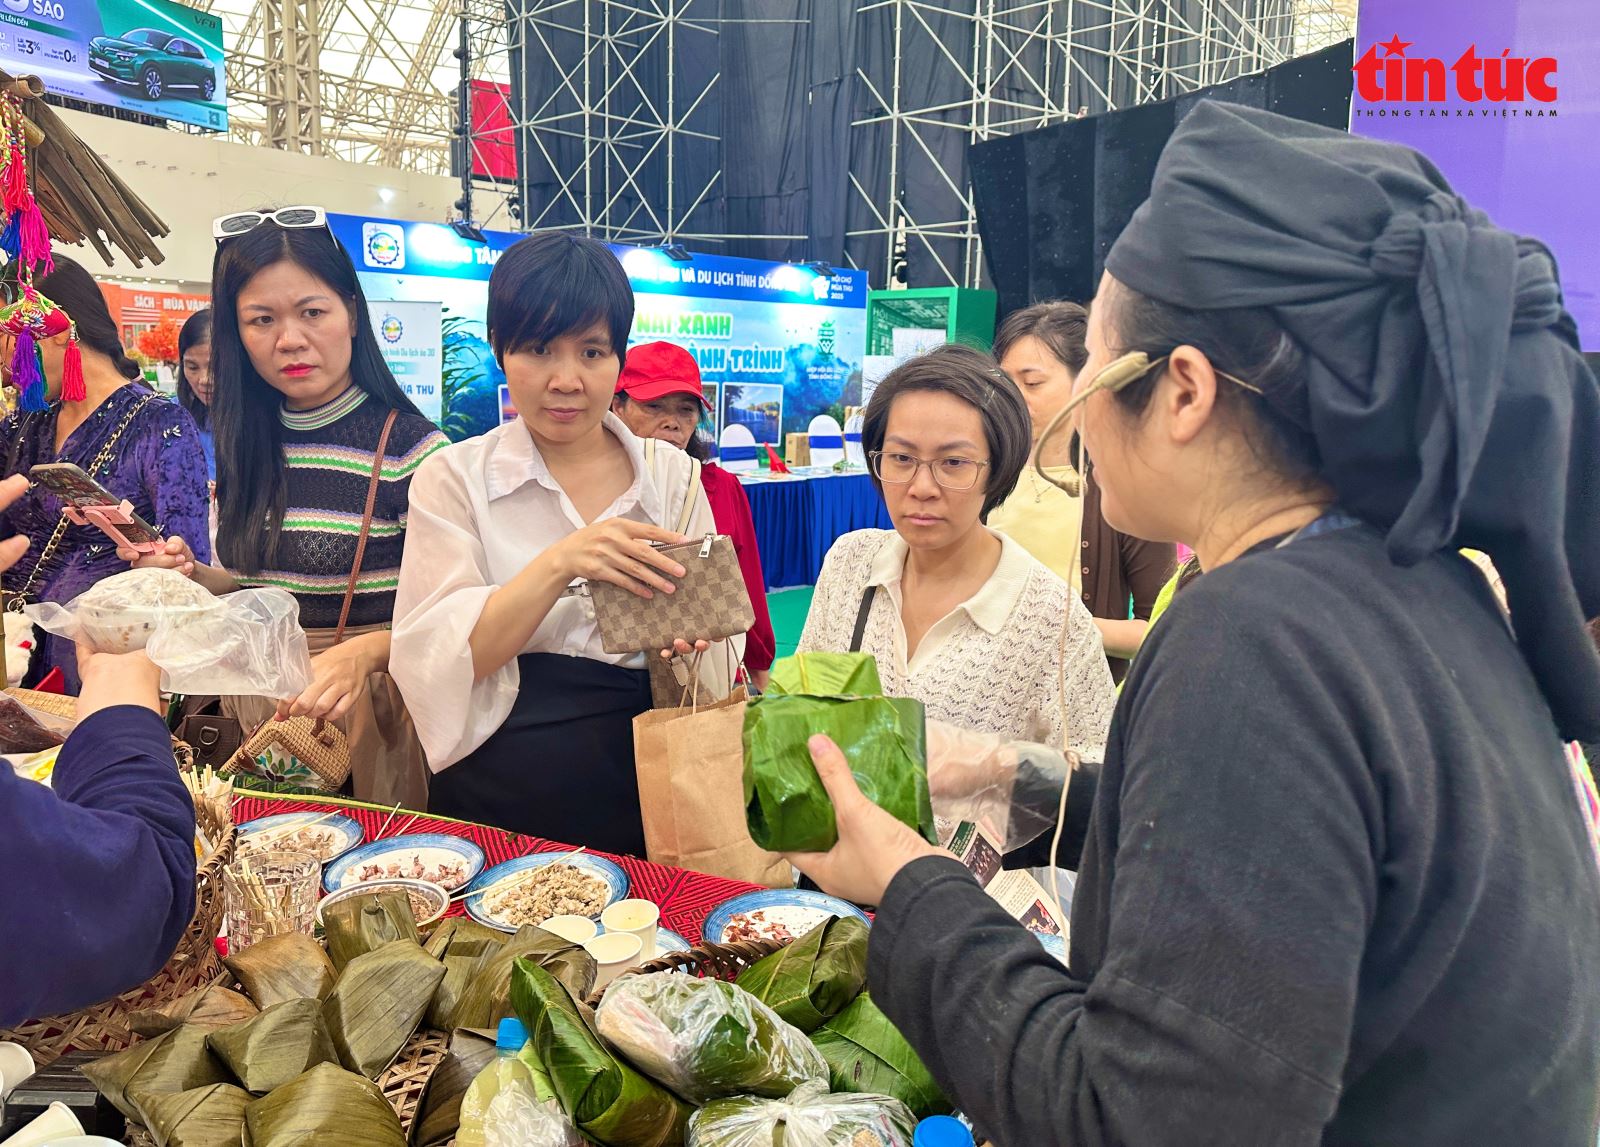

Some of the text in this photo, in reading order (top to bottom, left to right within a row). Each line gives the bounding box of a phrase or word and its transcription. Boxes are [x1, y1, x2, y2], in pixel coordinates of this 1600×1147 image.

[32, 0, 65, 21] SAO
[697, 269, 712, 284] DU
[713, 271, 734, 287] LỊCH
[678, 313, 732, 338] XANH
[730, 341, 784, 371] TRÌNH
[416, 384, 435, 395] THU
